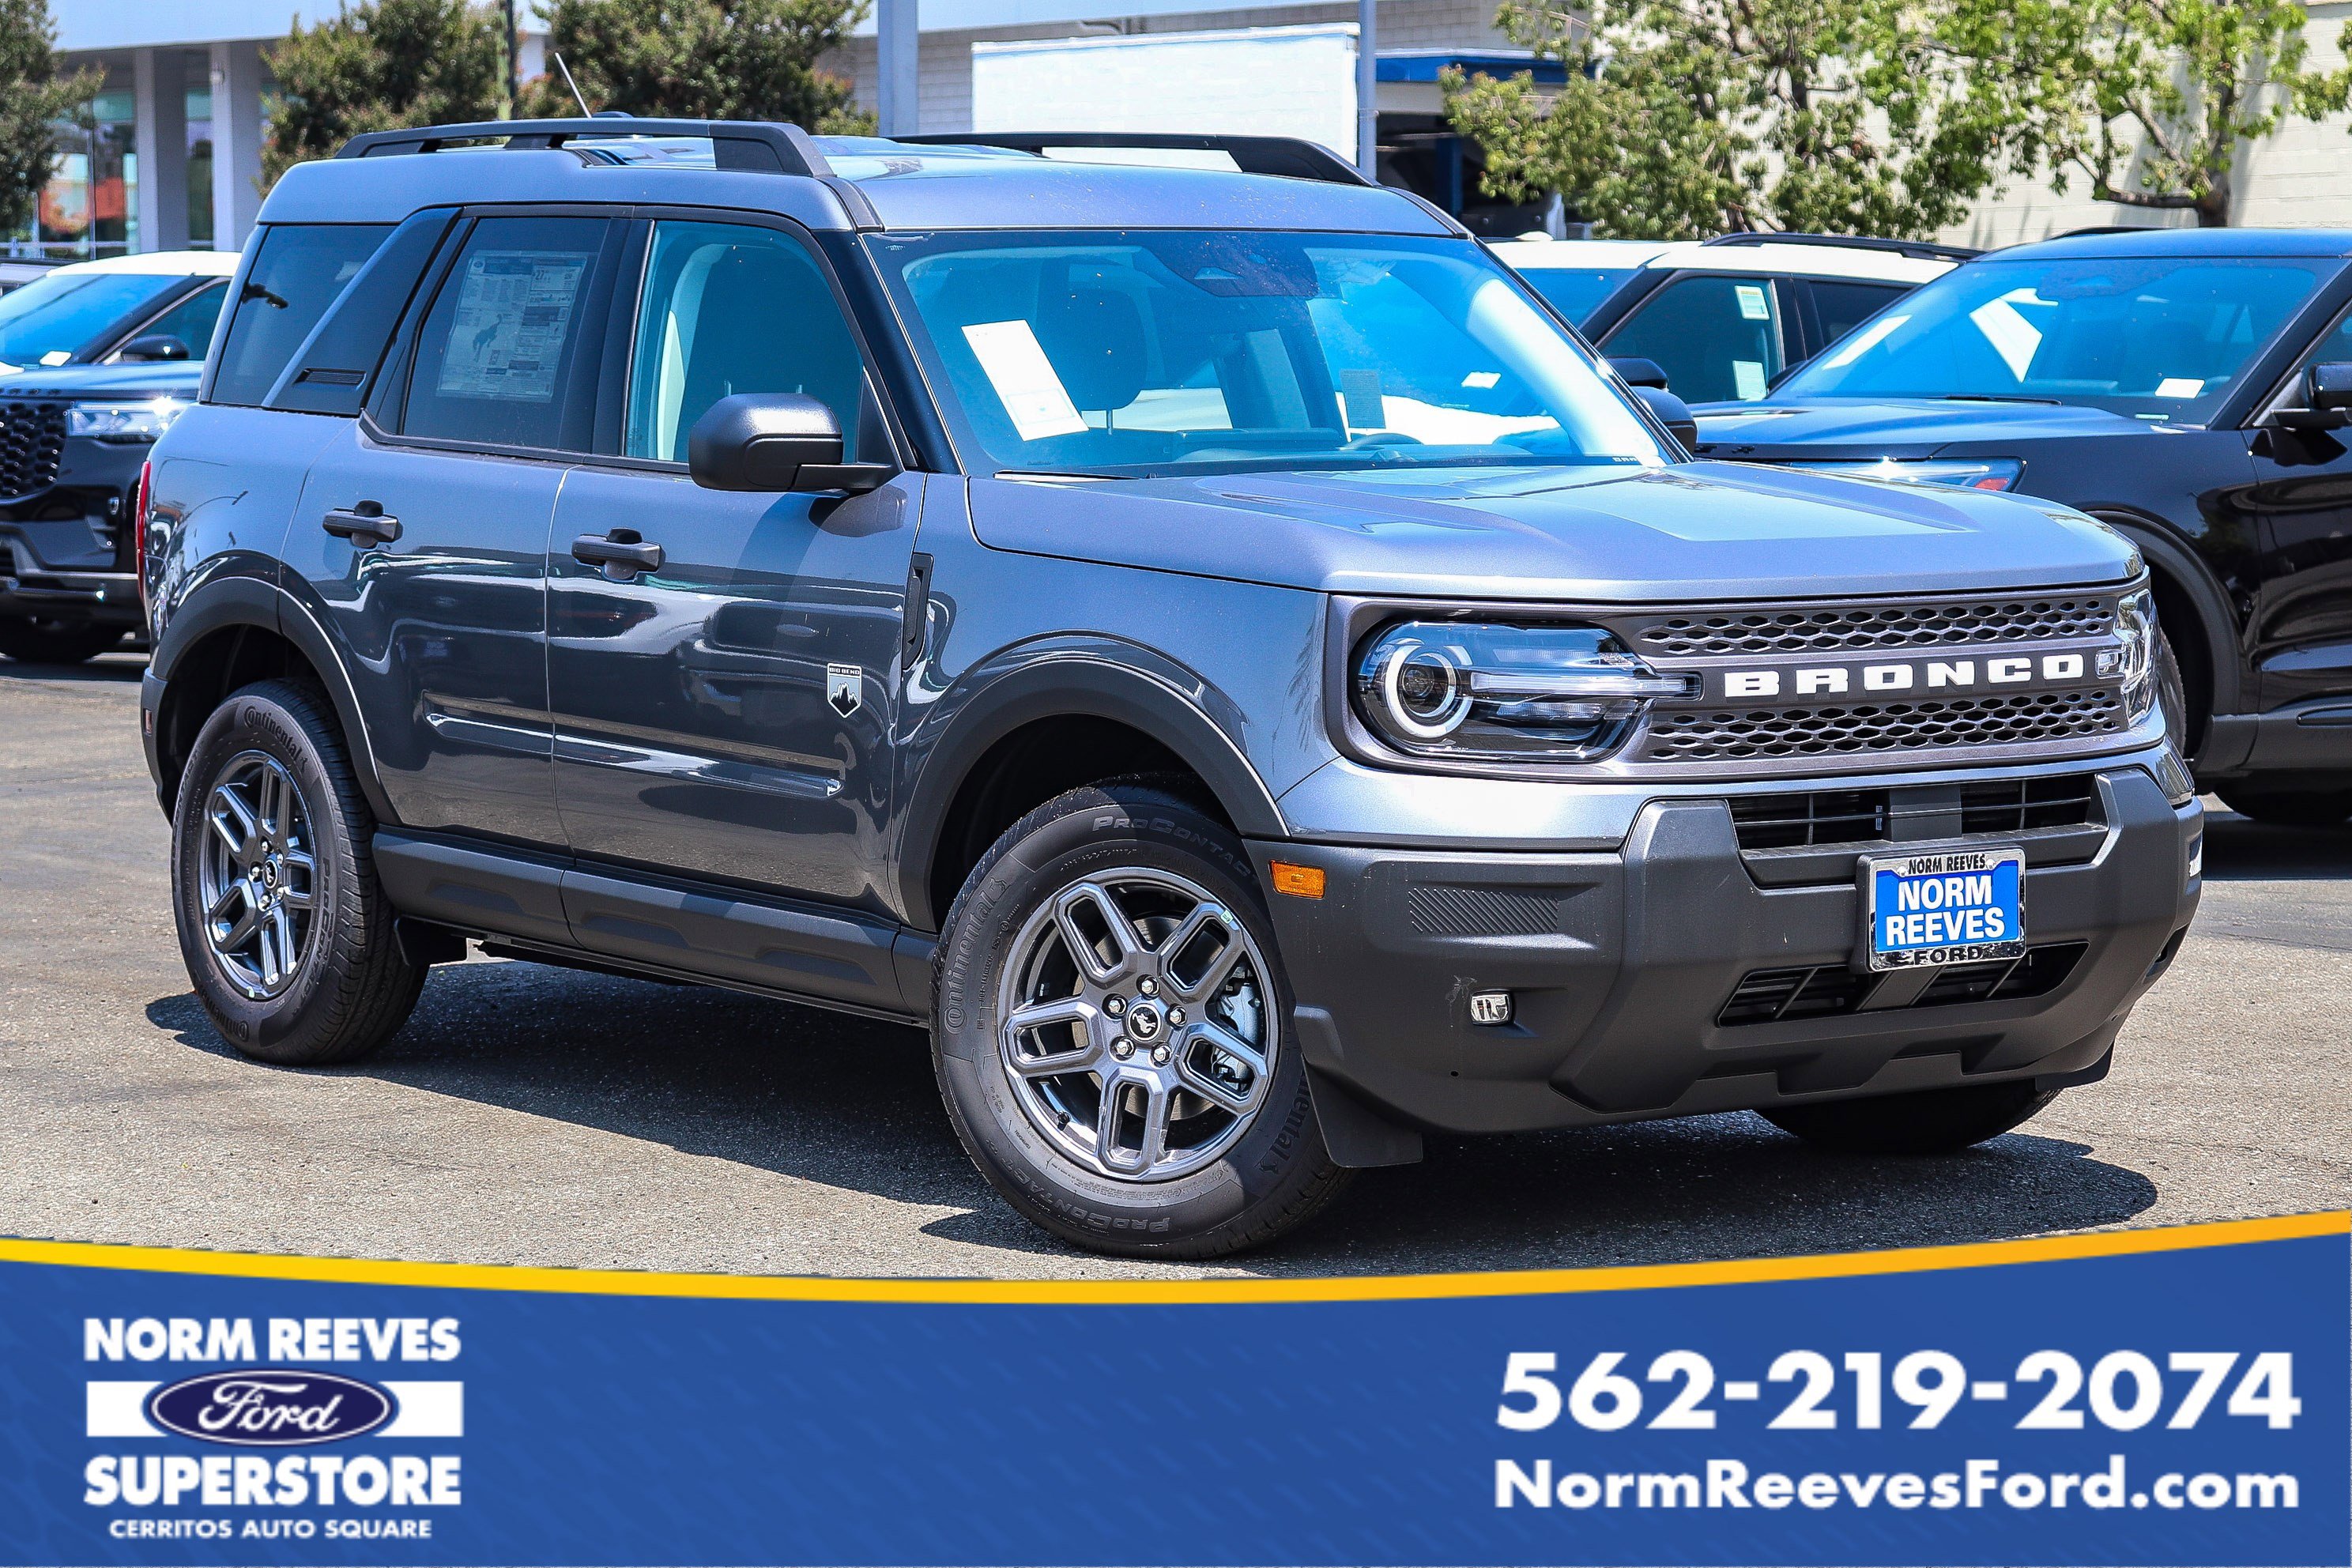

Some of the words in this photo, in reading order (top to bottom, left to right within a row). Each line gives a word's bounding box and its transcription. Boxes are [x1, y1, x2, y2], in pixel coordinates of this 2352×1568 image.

[1724, 654, 2084, 697] BRONCO
[243, 706, 303, 761] Continental
[1908, 857, 1943, 875] NORM
[1946, 853, 1986, 872] REEVES
[1898, 875, 1992, 911] NORM
[1886, 906, 2006, 947] REEVES
[944, 890, 998, 1035] Continental
[1913, 946, 1984, 965] FORD
